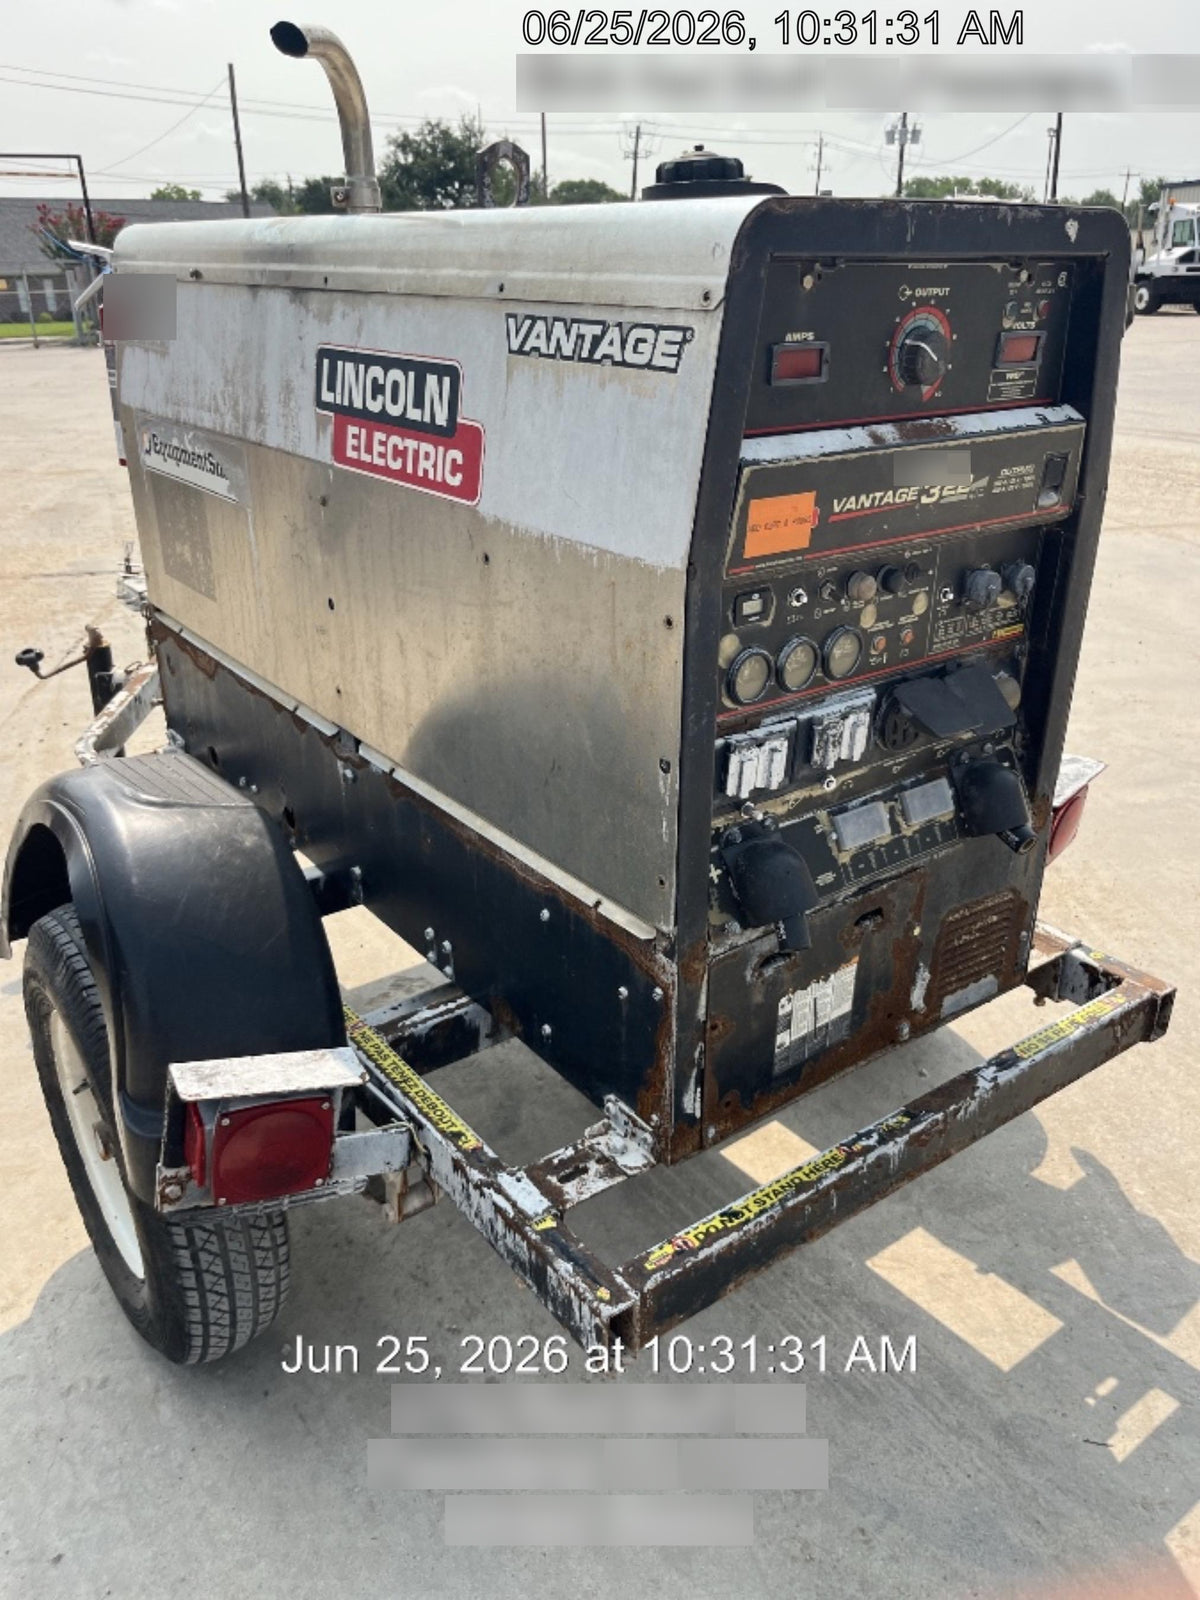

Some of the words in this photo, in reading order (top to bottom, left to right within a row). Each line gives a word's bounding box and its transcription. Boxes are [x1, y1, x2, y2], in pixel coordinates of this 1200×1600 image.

[506, 315, 684, 370] VANTAGE
[785, 330, 816, 342] AMPS
[320, 357, 451, 428] LINCOLN
[345, 424, 463, 487] ELECTRIC
[832, 486, 920, 513] VANTAGE
[370, 1043, 391, 1061] PAS
[415, 1088, 458, 1130] DEBOUT
[693, 1224, 719, 1241] DO
[719, 1203, 753, 1226] NOT
[753, 1175, 803, 1207] STAND
[806, 1152, 844, 1181] HERE
